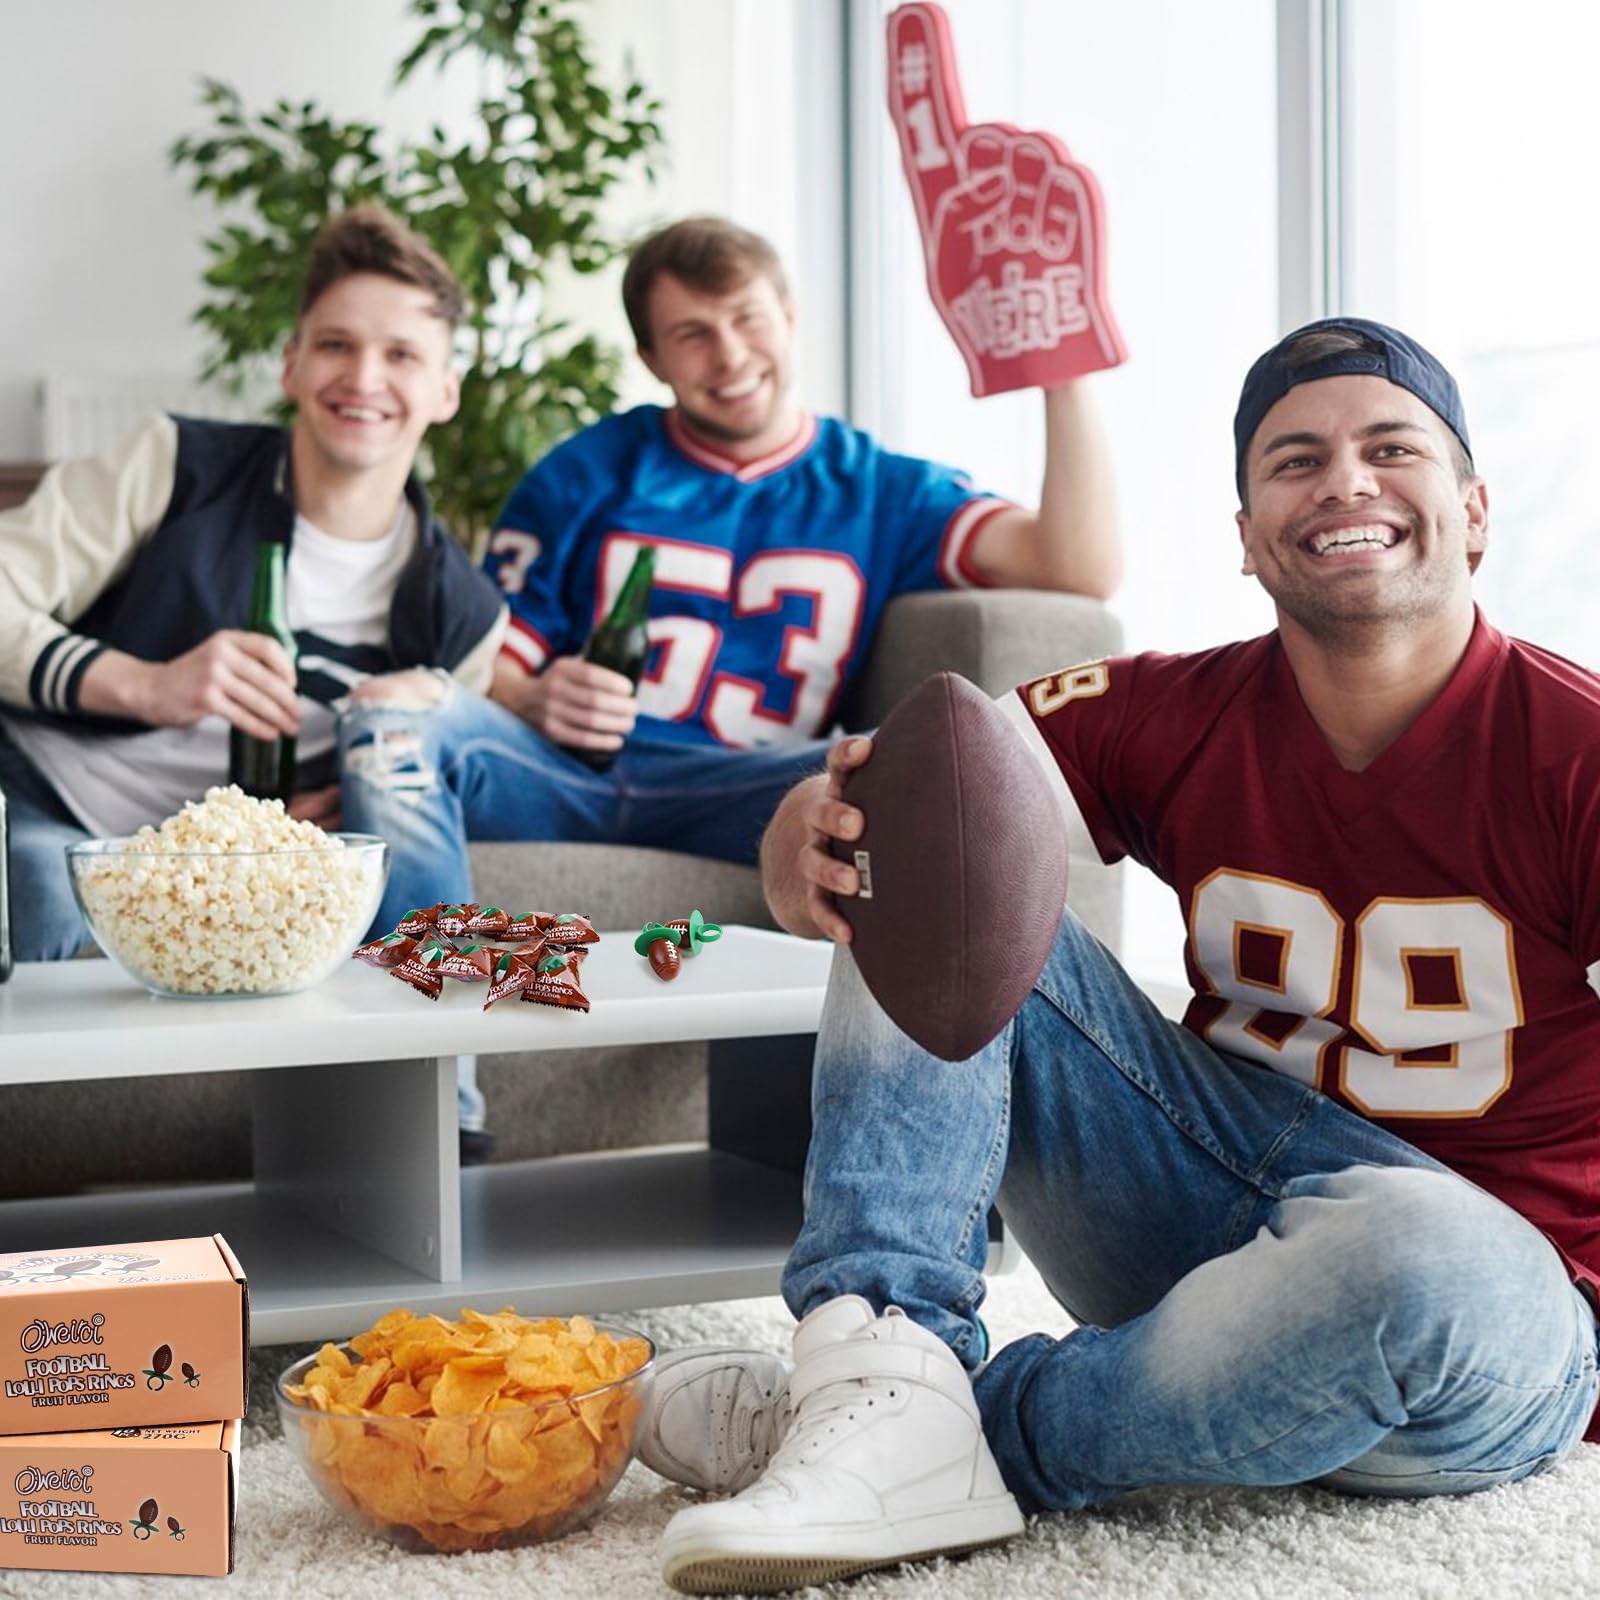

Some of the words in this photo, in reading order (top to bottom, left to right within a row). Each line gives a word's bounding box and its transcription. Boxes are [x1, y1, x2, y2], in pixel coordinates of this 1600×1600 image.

[596, 531, 867, 750] 53
[1191, 867, 1525, 1119] 89
[25, 1353, 111, 1378] FOOTBALL
[5, 1378, 45, 1397] LOLLI
[48, 1375, 85, 1393] POPS
[87, 1373, 135, 1391] RINGS
[32, 1395, 64, 1407] FRUIT
[67, 1393, 109, 1405] FLAVOR
[19, 1500, 99, 1518] FOOTBALL
[0, 1518, 37, 1534] LOLLI
[39, 1519, 75, 1534] POPS
[76, 1520, 122, 1536] RINGS
[24, 1535, 55, 1545] FRUIT
[57, 1536, 97, 1546] FLAVOR
